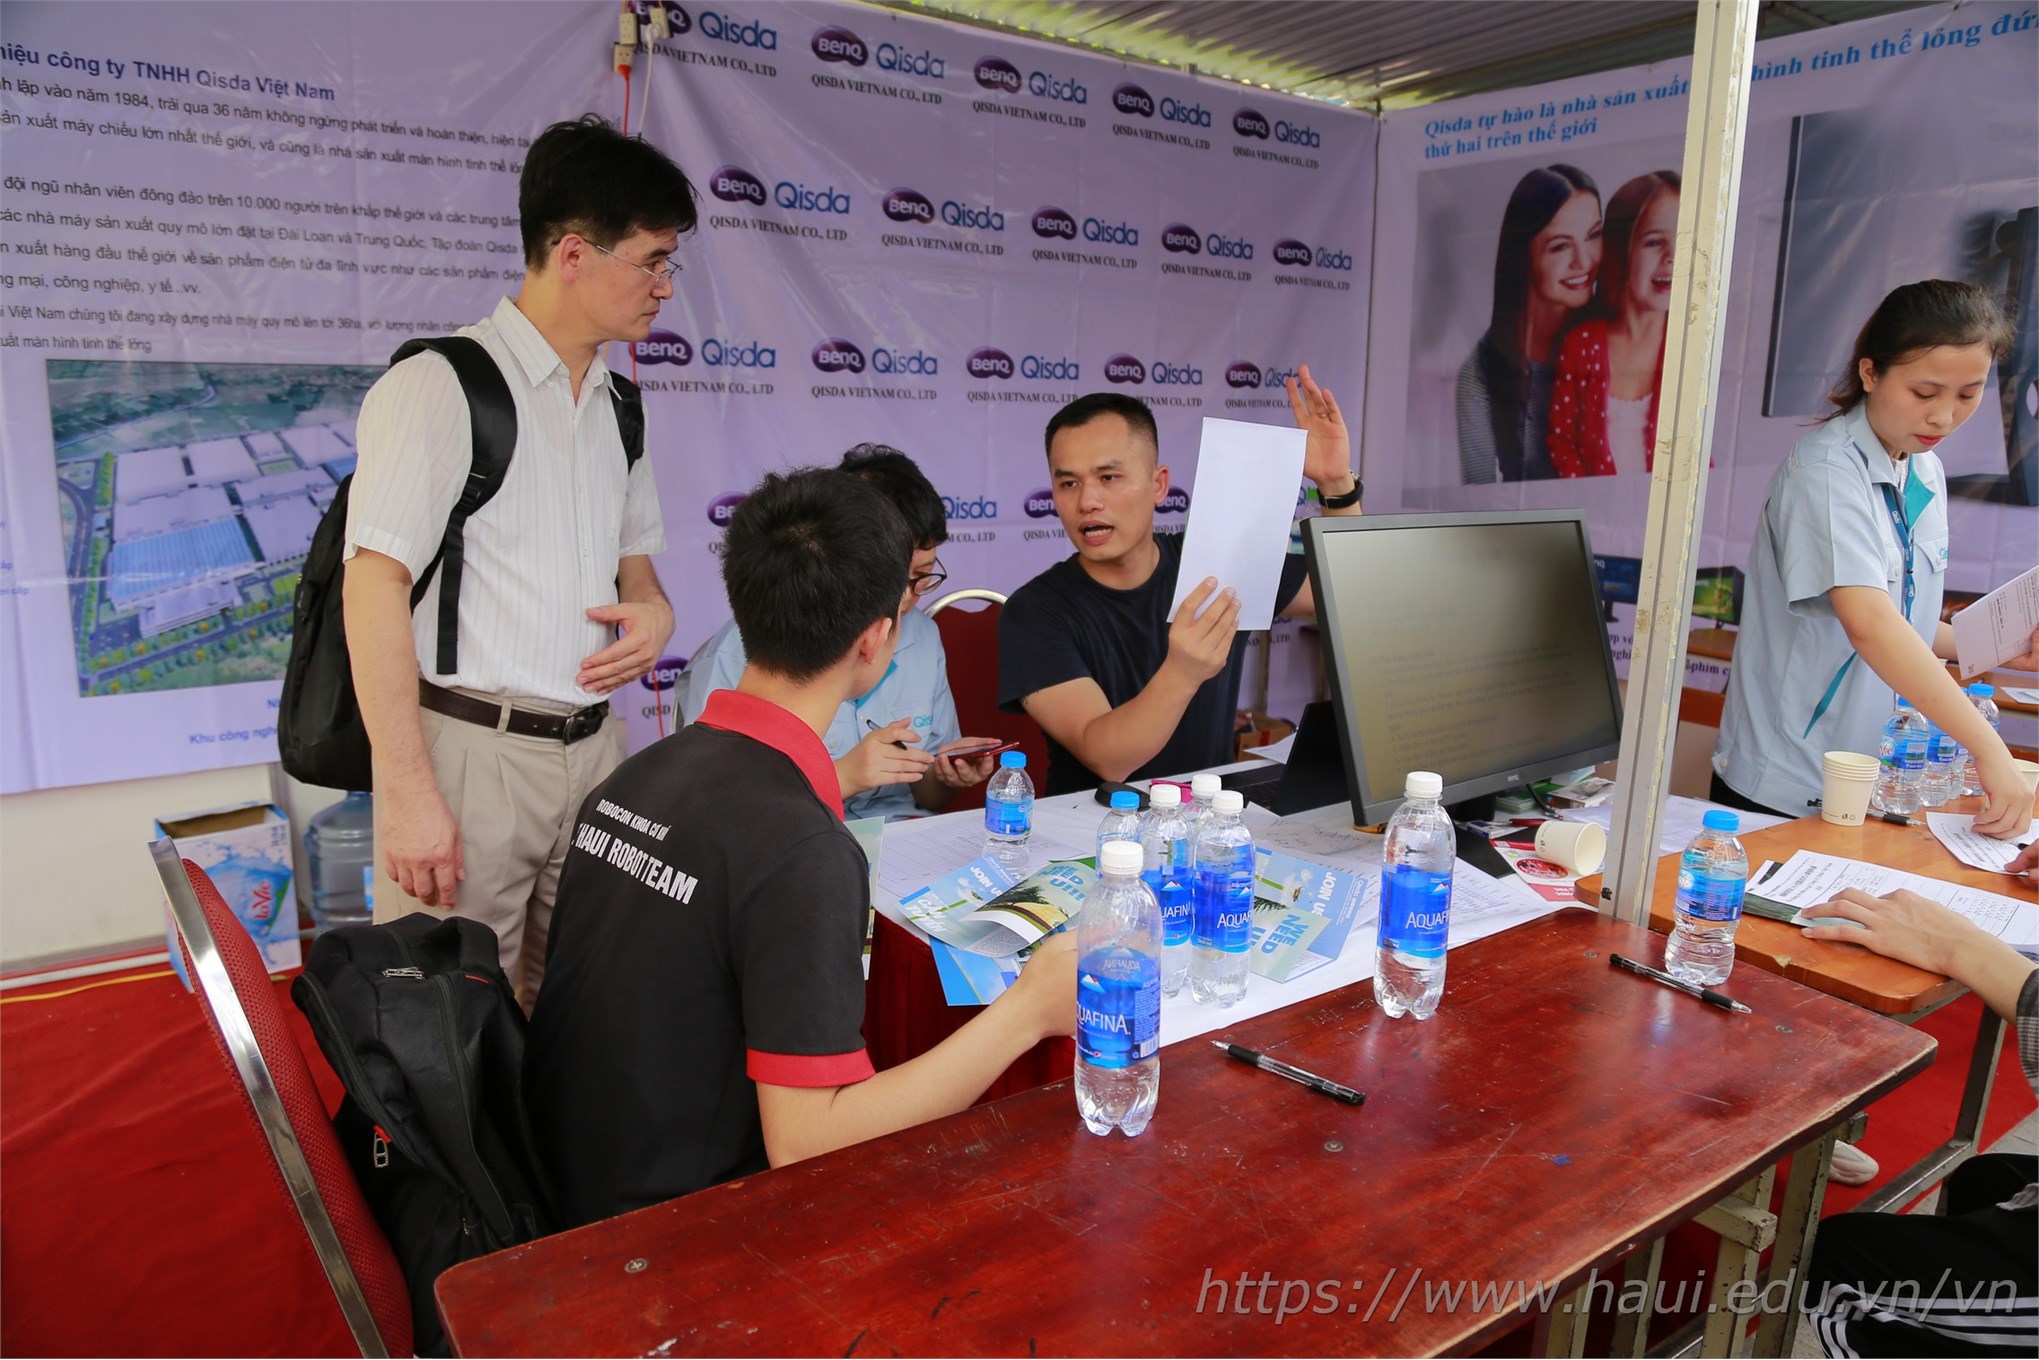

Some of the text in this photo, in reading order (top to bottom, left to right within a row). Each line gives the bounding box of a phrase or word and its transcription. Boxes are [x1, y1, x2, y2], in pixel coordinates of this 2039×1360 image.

[699, 11, 777, 50] Qisda
[671, 48, 727, 68] VIETNAM
[755, 63, 777, 77] LTD
[876, 42, 945, 79] Qisda
[1752, 61, 1802, 82] hình
[1811, 46, 1860, 71] tinh
[1871, 28, 1913, 60] thể
[1921, 24, 1982, 50] lỏng
[47, 52, 100, 76] công
[106, 58, 125, 78] ty
[133, 61, 190, 83] TNHH
[196, 70, 251, 91] Qisda
[255, 76, 289, 98] Việt
[295, 82, 335, 101] Nam
[812, 73, 846, 89] QISDA
[848, 79, 898, 99] VIETNAM
[922, 90, 942, 105] LTD
[1028, 70, 1087, 105] Qisda
[17, 79, 40, 97] lập
[45, 84, 72, 98] vào
[77, 88, 109, 103] năm
[116, 92, 154, 109] 1984,
[184, 103, 208, 117] qua
[213, 104, 229, 117] 36
[234, 105, 262, 120] năm
[266, 109, 305, 127] không
[972, 100, 1002, 115] QISDA
[1004, 104, 1048, 124] VIETNAM
[1070, 115, 1086, 129] LTD
[1159, 97, 1211, 128] Qisda
[1425, 74, 1690, 138] Qisda tự hào là nhà sản xuất
[26, 111, 57, 129] xuất
[63, 119, 94, 136] máy
[99, 119, 137, 139] chiếu
[260, 139, 275, 151] và
[1275, 120, 1320, 149] Qisda
[1425, 118, 1597, 159] thứ hai trên thế giới
[4, 176, 26, 192] đội
[31, 180, 59, 196] ngũ
[65, 183, 100, 197] nhân
[106, 186, 135, 200] viên
[140, 188, 174, 205] đông
[208, 194, 234, 207] trên
[237, 196, 280, 211] 10.000
[774, 181, 850, 214] Qisda
[27, 211, 55, 225] nhà
[60, 214, 91, 230] máy
[125, 215, 153, 231] xuất
[158, 222, 182, 236] quy
[187, 221, 208, 235] mô
[303, 229, 334, 243] Loan
[356, 233, 390, 248] Trung
[710, 215, 748, 230] QISDA
[751, 219, 799, 237] VIETNAM
[824, 227, 847, 241] LTD
[941, 201, 1004, 232] Qisda
[1083, 217, 1138, 246] Qisda
[16, 239, 48, 256] xuất
[54, 244, 90, 260] hàng
[1032, 248, 1060, 263] QISDA
[1061, 252, 1102, 267] VIETNAM
[1122, 258, 1137, 270] LTD
[1206, 233, 1253, 260] Qisda
[19, 274, 49, 289] mại,
[53, 275, 89, 291] công
[8, 304, 32, 320] Việt
[36, 307, 65, 319] Nam
[126, 310, 155, 325] đang
[23, 336, 49, 348] màn
[701, 338, 775, 370] Qisda
[872, 348, 938, 376] Qisda
[1021, 354, 1079, 381] Qisda
[1152, 361, 1202, 385] Qisda
[812, 386, 846, 399] QISDA
[850, 386, 895, 400] VIETNAM
[917, 389, 937, 401] LTD
[596, 799, 634, 825] ROBOCON
[630, 814, 652, 834] KHOA
[575, 823, 611, 858] HAUI
[970, 866, 993, 888] JOIN
[1318, 872, 1336, 901] JOIN
[1261, 914, 1301, 954] NEED
